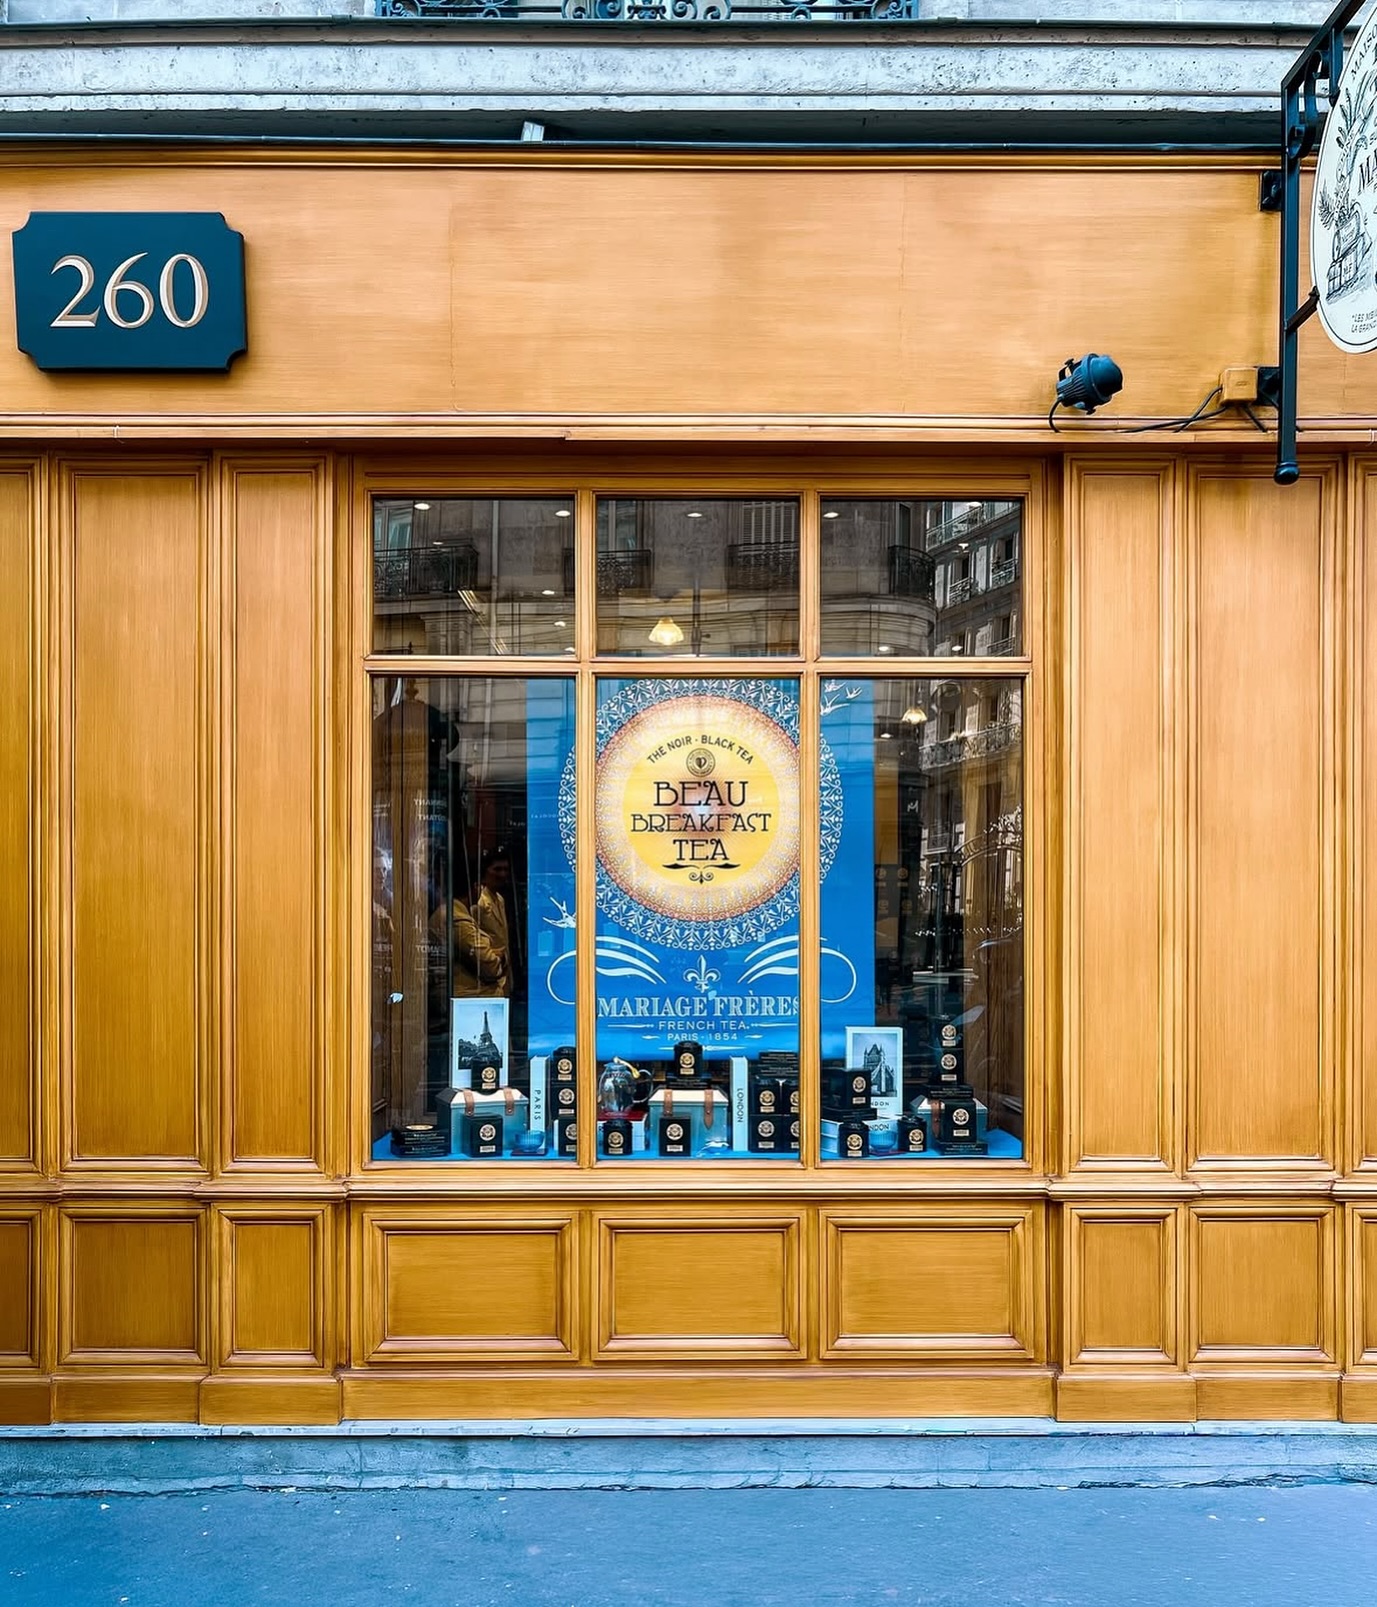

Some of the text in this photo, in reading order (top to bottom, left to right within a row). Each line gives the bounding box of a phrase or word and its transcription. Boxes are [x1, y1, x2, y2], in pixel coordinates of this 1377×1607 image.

[50, 252, 209, 329] 260
[667, 735, 692, 751] NOIR
[701, 735, 736, 751] BLACK
[736, 746, 754, 765] TEA
[653, 780, 749, 806] BEAU
[630, 813, 772, 832] BREAKFAST
[673, 839, 730, 861] TEA
[597, 996, 708, 1018] MARIAGE
[658, 1020, 715, 1030] FRENCH
[667, 1032, 738, 1041] PARIS 1854
[534, 1089, 542, 1121] PARIS
[737, 1087, 745, 1123] LONDON
